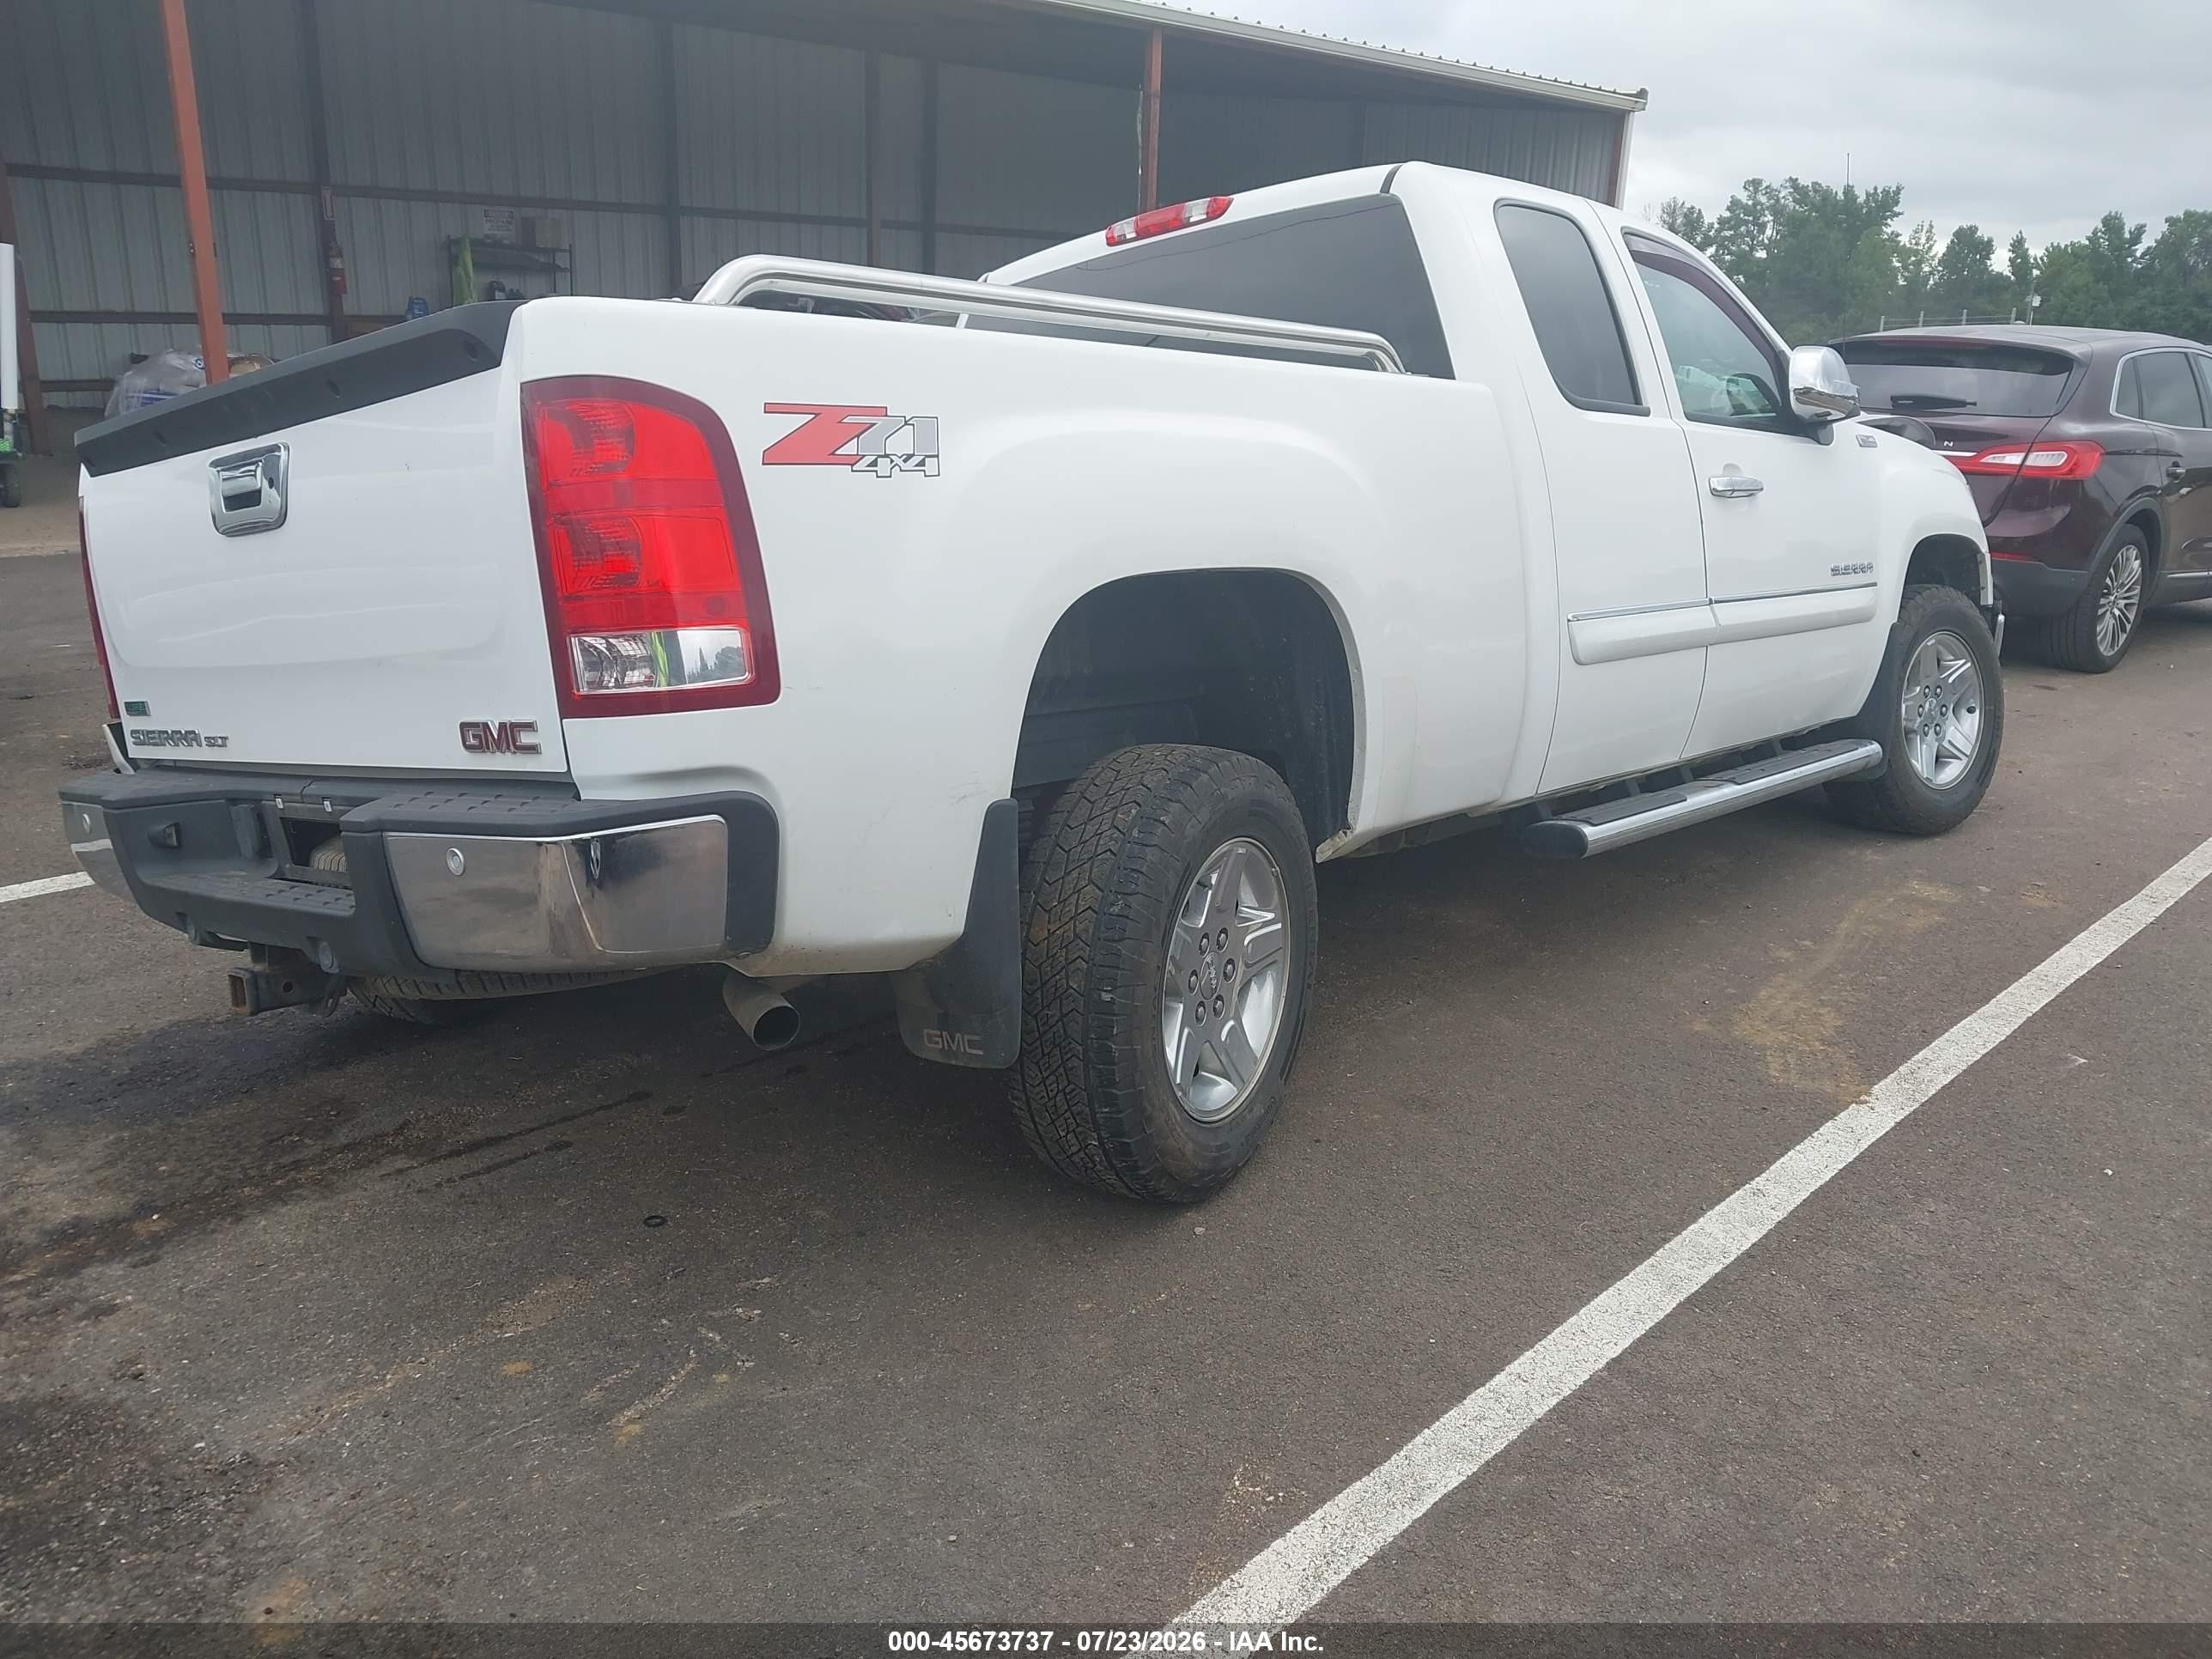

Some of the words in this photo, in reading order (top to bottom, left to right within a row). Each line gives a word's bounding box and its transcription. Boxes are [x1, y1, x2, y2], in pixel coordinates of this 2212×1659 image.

[762, 402, 939, 465] Z71
[1830, 562, 1875, 576] SIERRA
[130, 728, 203, 747] SIERRA
[204, 735, 229, 748] SLT
[459, 720, 542, 755] GMC
[922, 1029, 984, 1055] GMC
